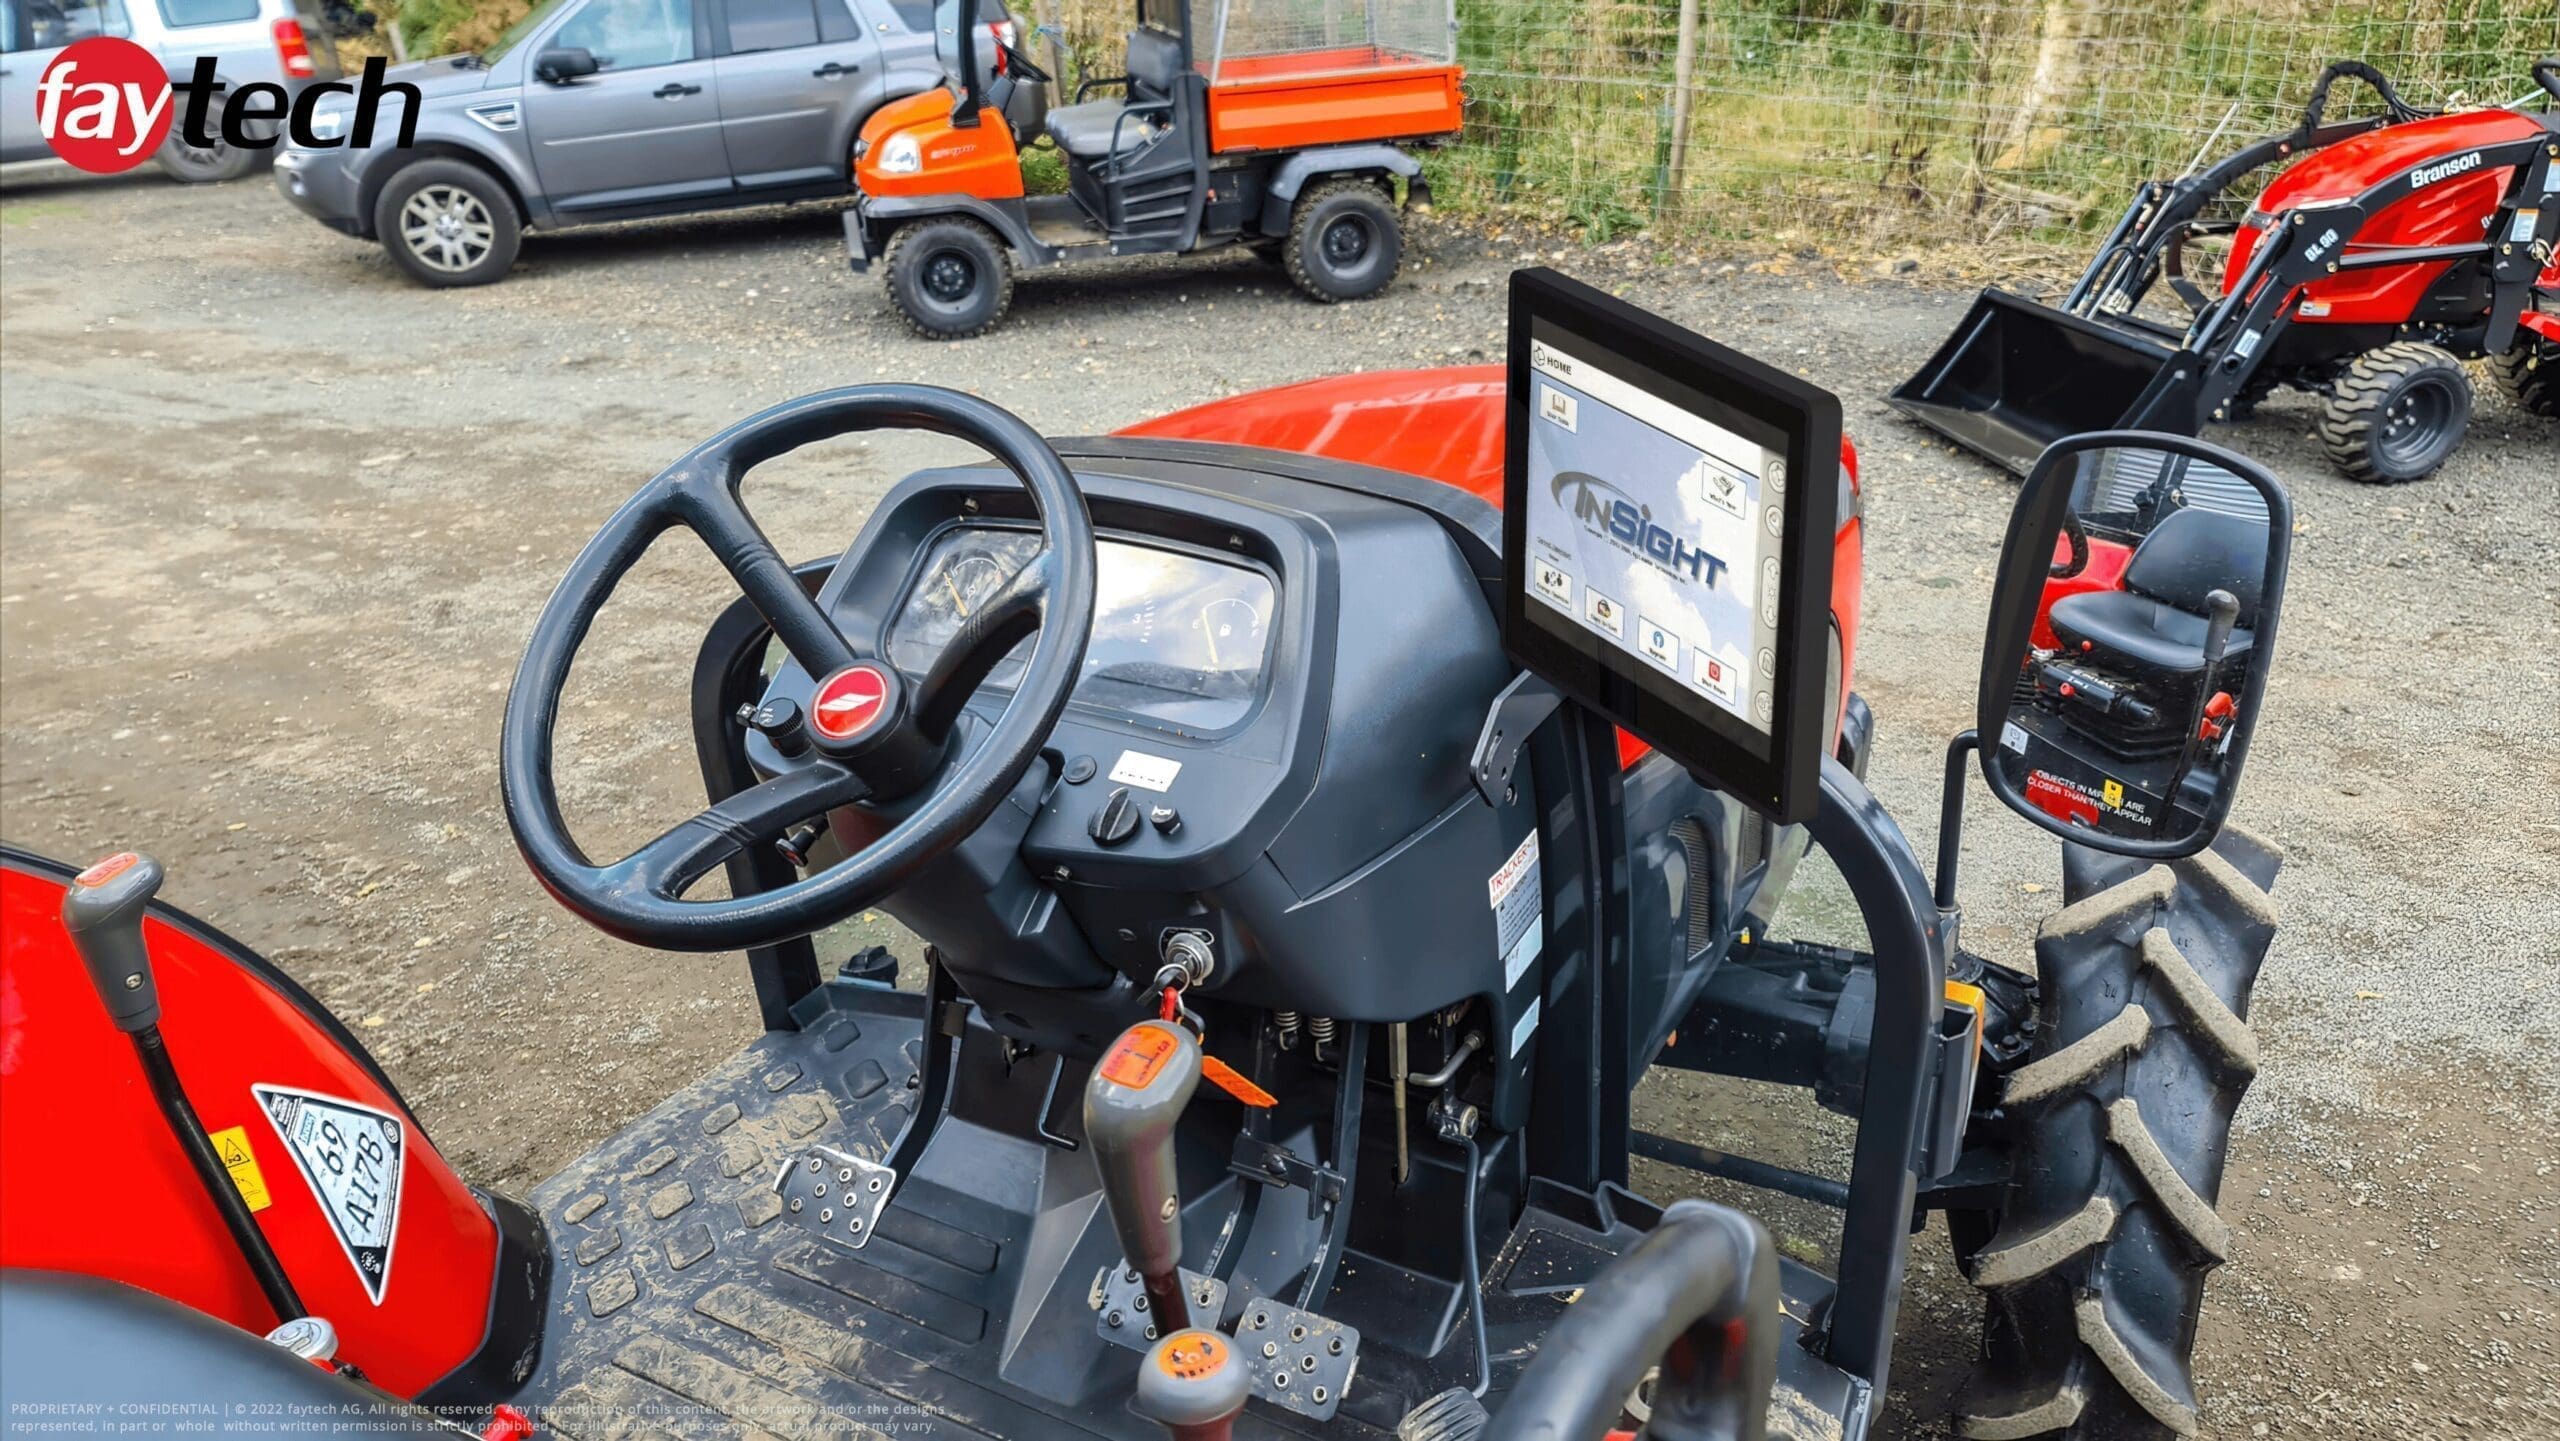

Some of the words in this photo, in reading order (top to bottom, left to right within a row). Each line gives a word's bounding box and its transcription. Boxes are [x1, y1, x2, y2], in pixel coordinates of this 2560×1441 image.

[2410, 151, 2482, 189] Branson
[1547, 356, 1572, 375] HOME
[2027, 776, 2061, 795] CLOSER
[2063, 790, 2088, 805] THAN
[2087, 797, 2113, 812] THEY
[2114, 807, 2152, 826] APPEAR
[2036, 769, 2076, 789] OBJECTS
[2077, 784, 2087, 794] IN
[2125, 800, 2145, 813] ARE
[316, 1120, 349, 1177] 69
